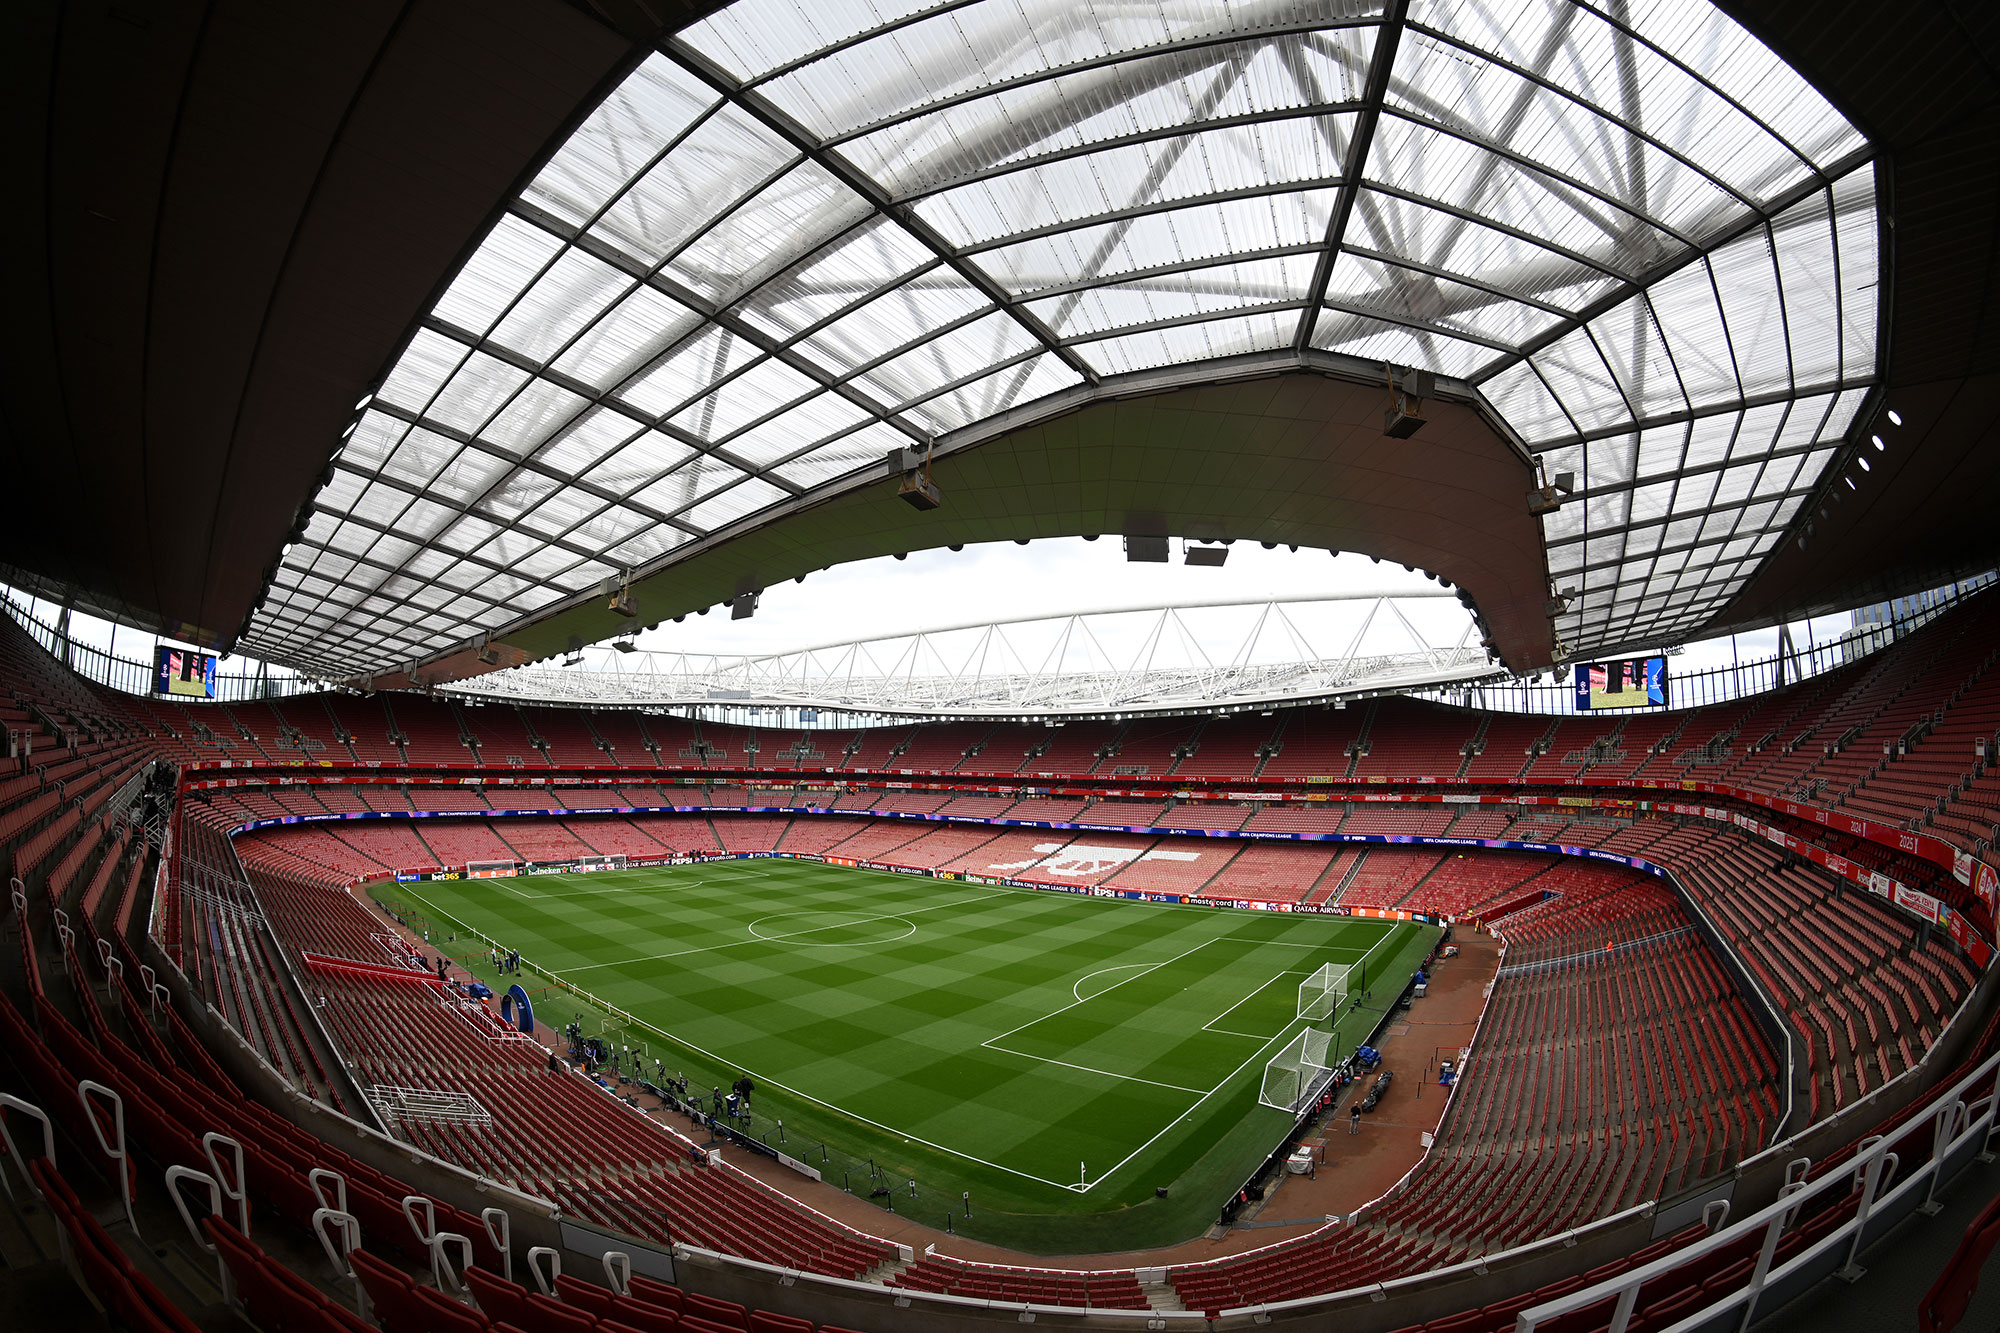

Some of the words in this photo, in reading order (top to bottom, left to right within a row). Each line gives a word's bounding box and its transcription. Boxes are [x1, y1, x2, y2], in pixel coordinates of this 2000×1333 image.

[1850, 820, 1862, 833] 2024
[1899, 834, 1914, 850] 2025
[1598, 852, 1615, 861] CHAMPIONS
[640, 859, 661, 867] AIRWAYS
[432, 871, 459, 881] bet365
[1094, 886, 1115, 897] EPSI
[1236, 900, 1258, 910] FedEx
[1293, 905, 1318, 914] QATAR
[1319, 906, 1349, 915] AIRWAS
